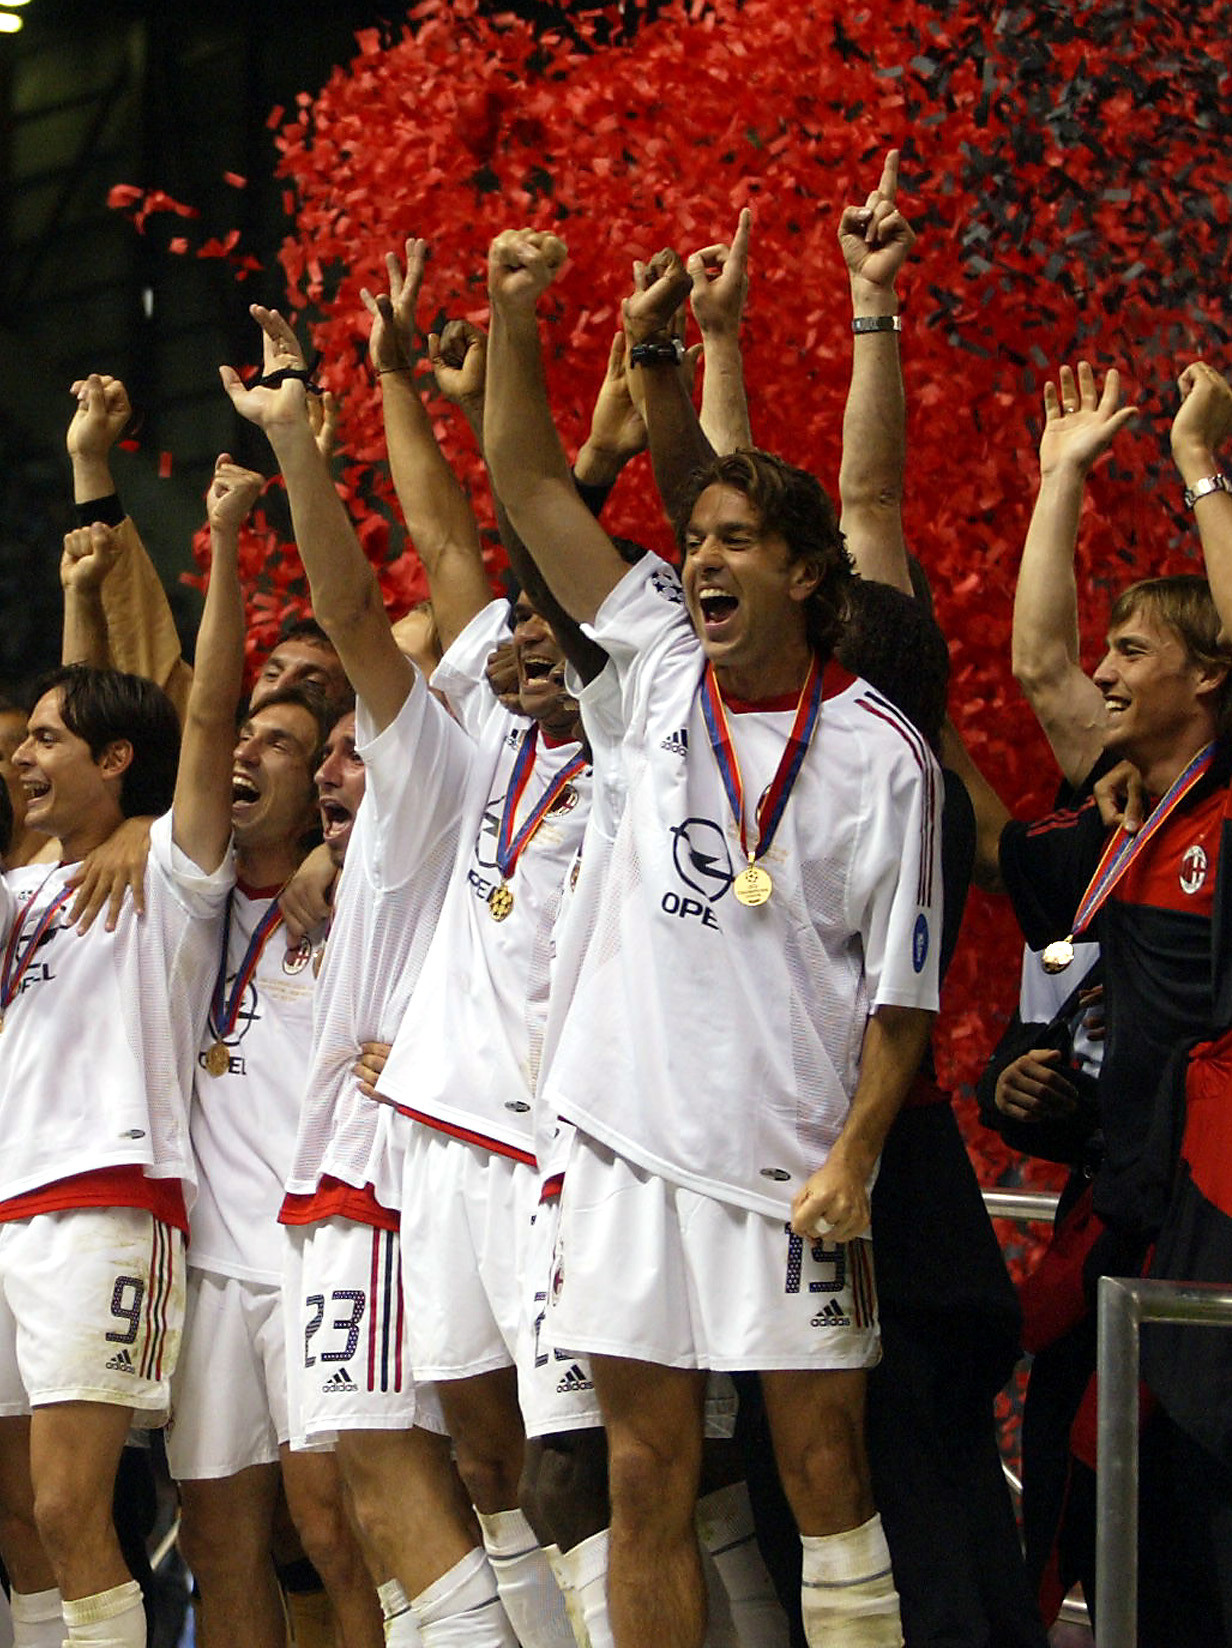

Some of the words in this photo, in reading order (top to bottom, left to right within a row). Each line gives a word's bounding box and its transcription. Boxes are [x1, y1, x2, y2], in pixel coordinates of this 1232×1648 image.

[468, 869, 497, 902] PEL
[661, 892, 721, 931] OPE
[105, 1275, 144, 1345] 9
[810, 1317, 851, 1327] adidas
[305, 1290, 366, 1368] 23
[322, 1382, 359, 1393] adidas
[556, 1380, 595, 1394] adidas
